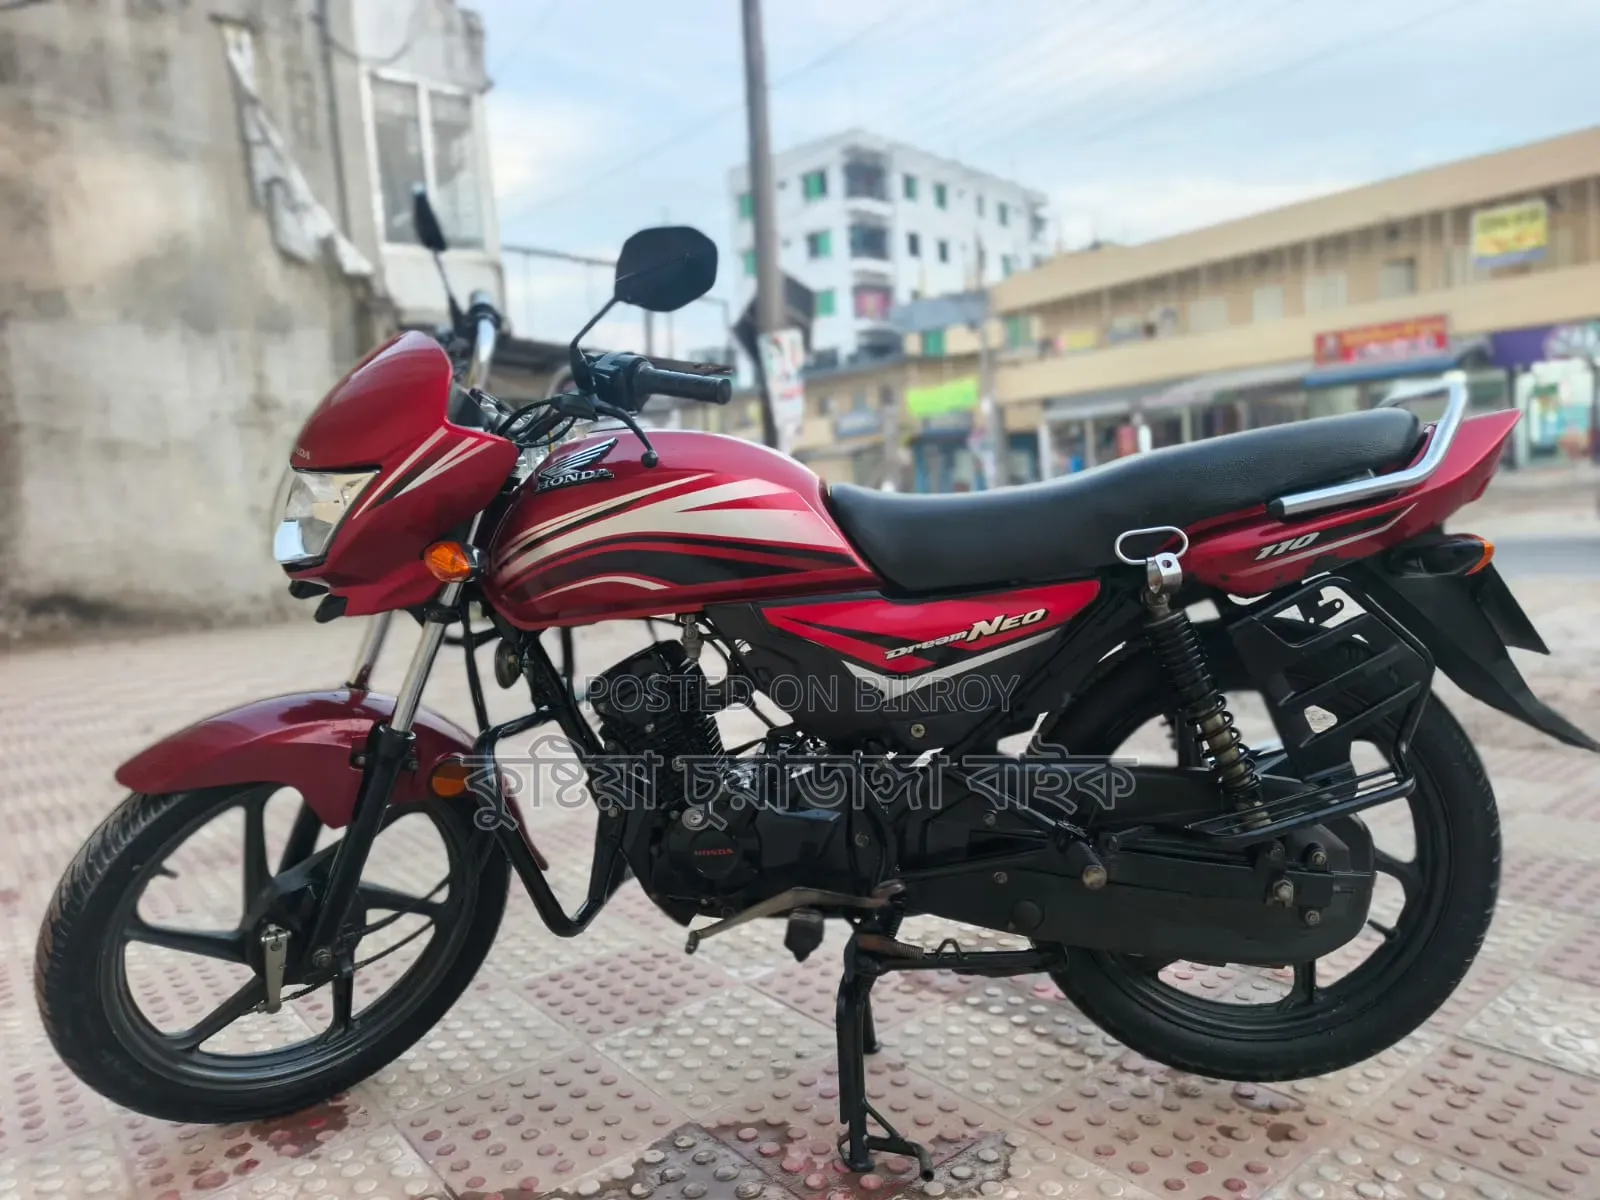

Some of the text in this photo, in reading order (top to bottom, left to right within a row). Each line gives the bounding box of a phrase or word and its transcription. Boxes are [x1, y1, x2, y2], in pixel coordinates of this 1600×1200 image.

[535, 468, 612, 492] HONDA
[1255, 531, 1320, 560] 110
[884, 630, 968, 660] Dream
